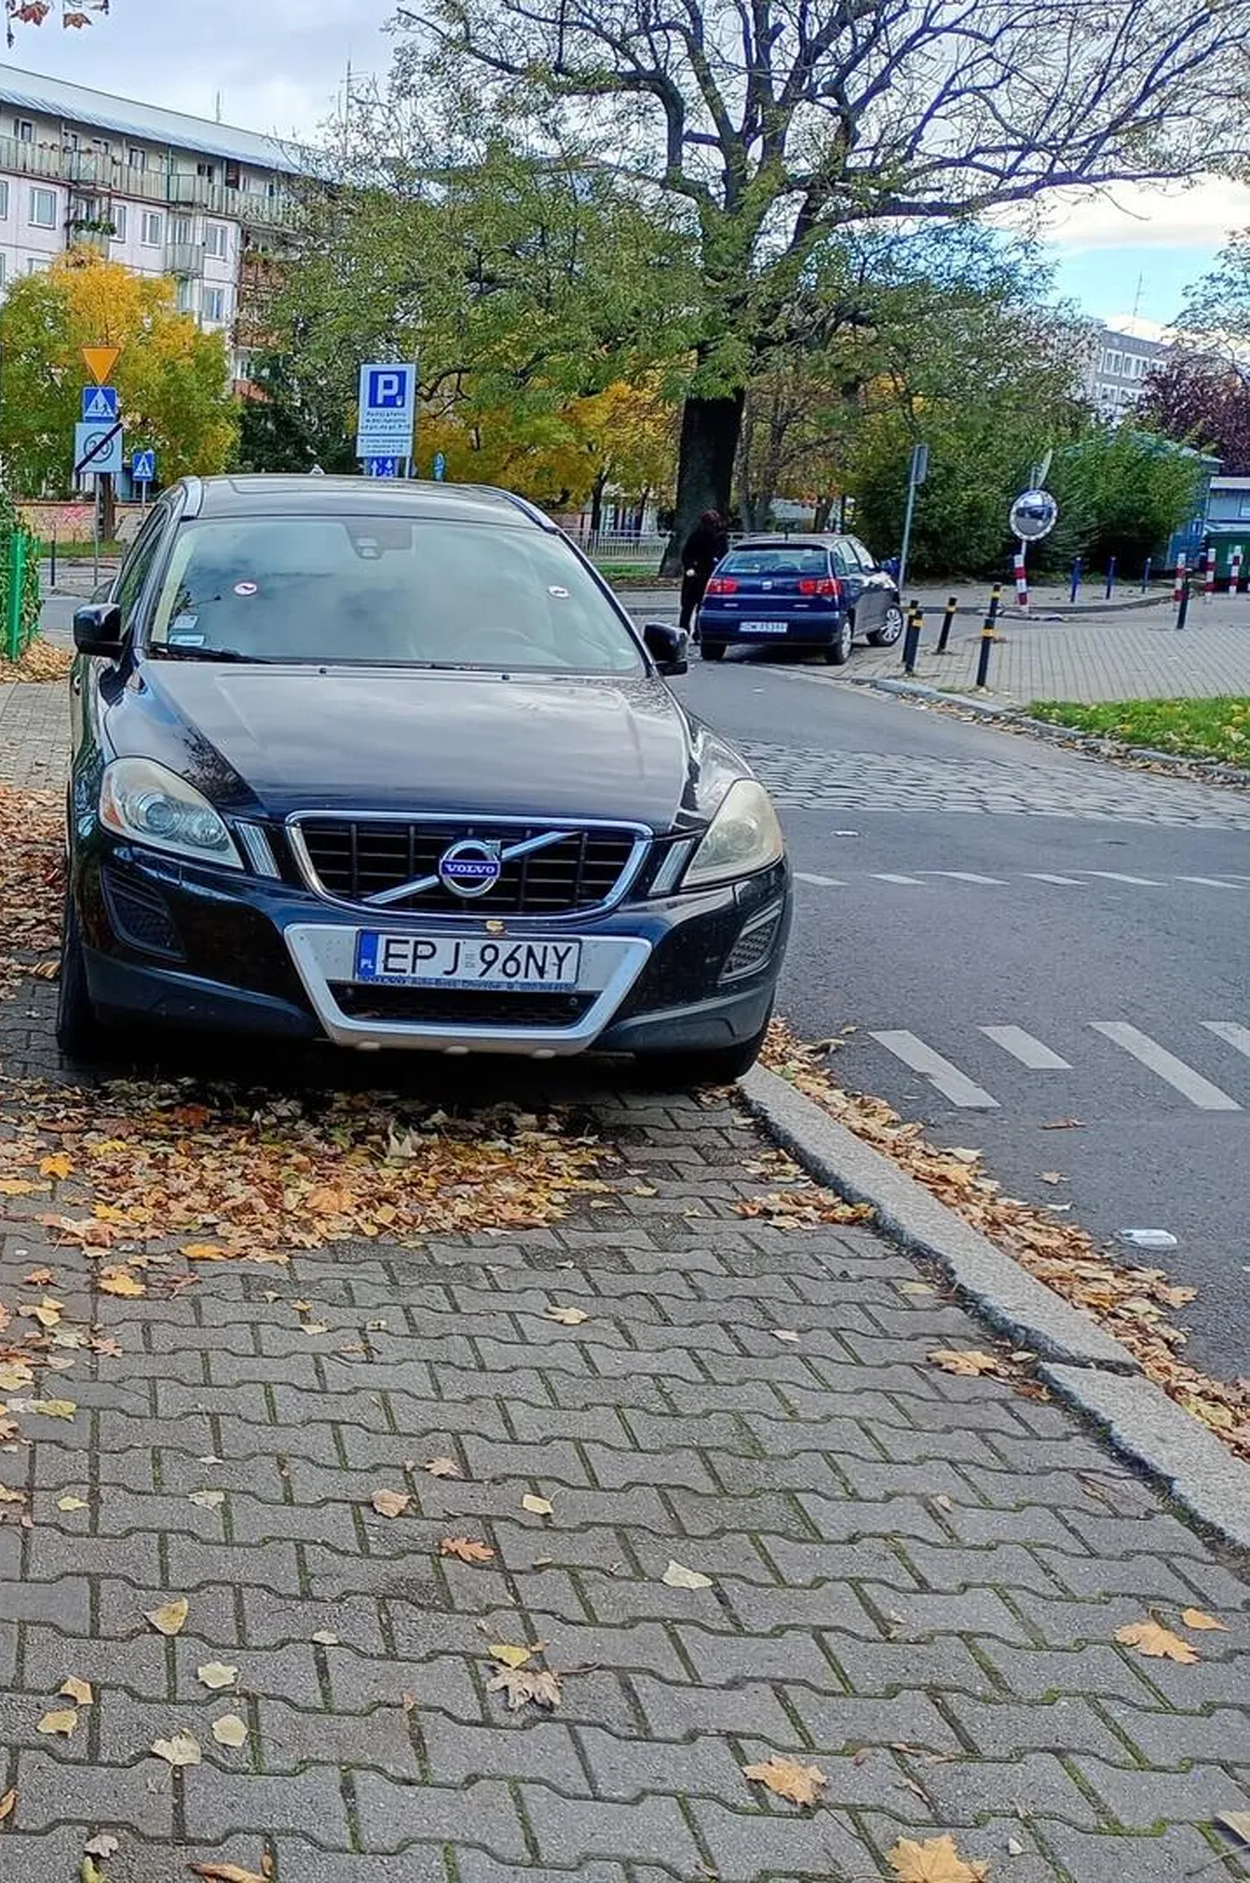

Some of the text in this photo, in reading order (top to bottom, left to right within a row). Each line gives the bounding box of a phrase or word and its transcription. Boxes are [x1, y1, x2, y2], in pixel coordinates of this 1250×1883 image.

[377, 374, 399, 404] P
[445, 864, 495, 874] VOLVO
[360, 959, 373, 970] PL
[383, 939, 573, 980] EPJ 96NY
